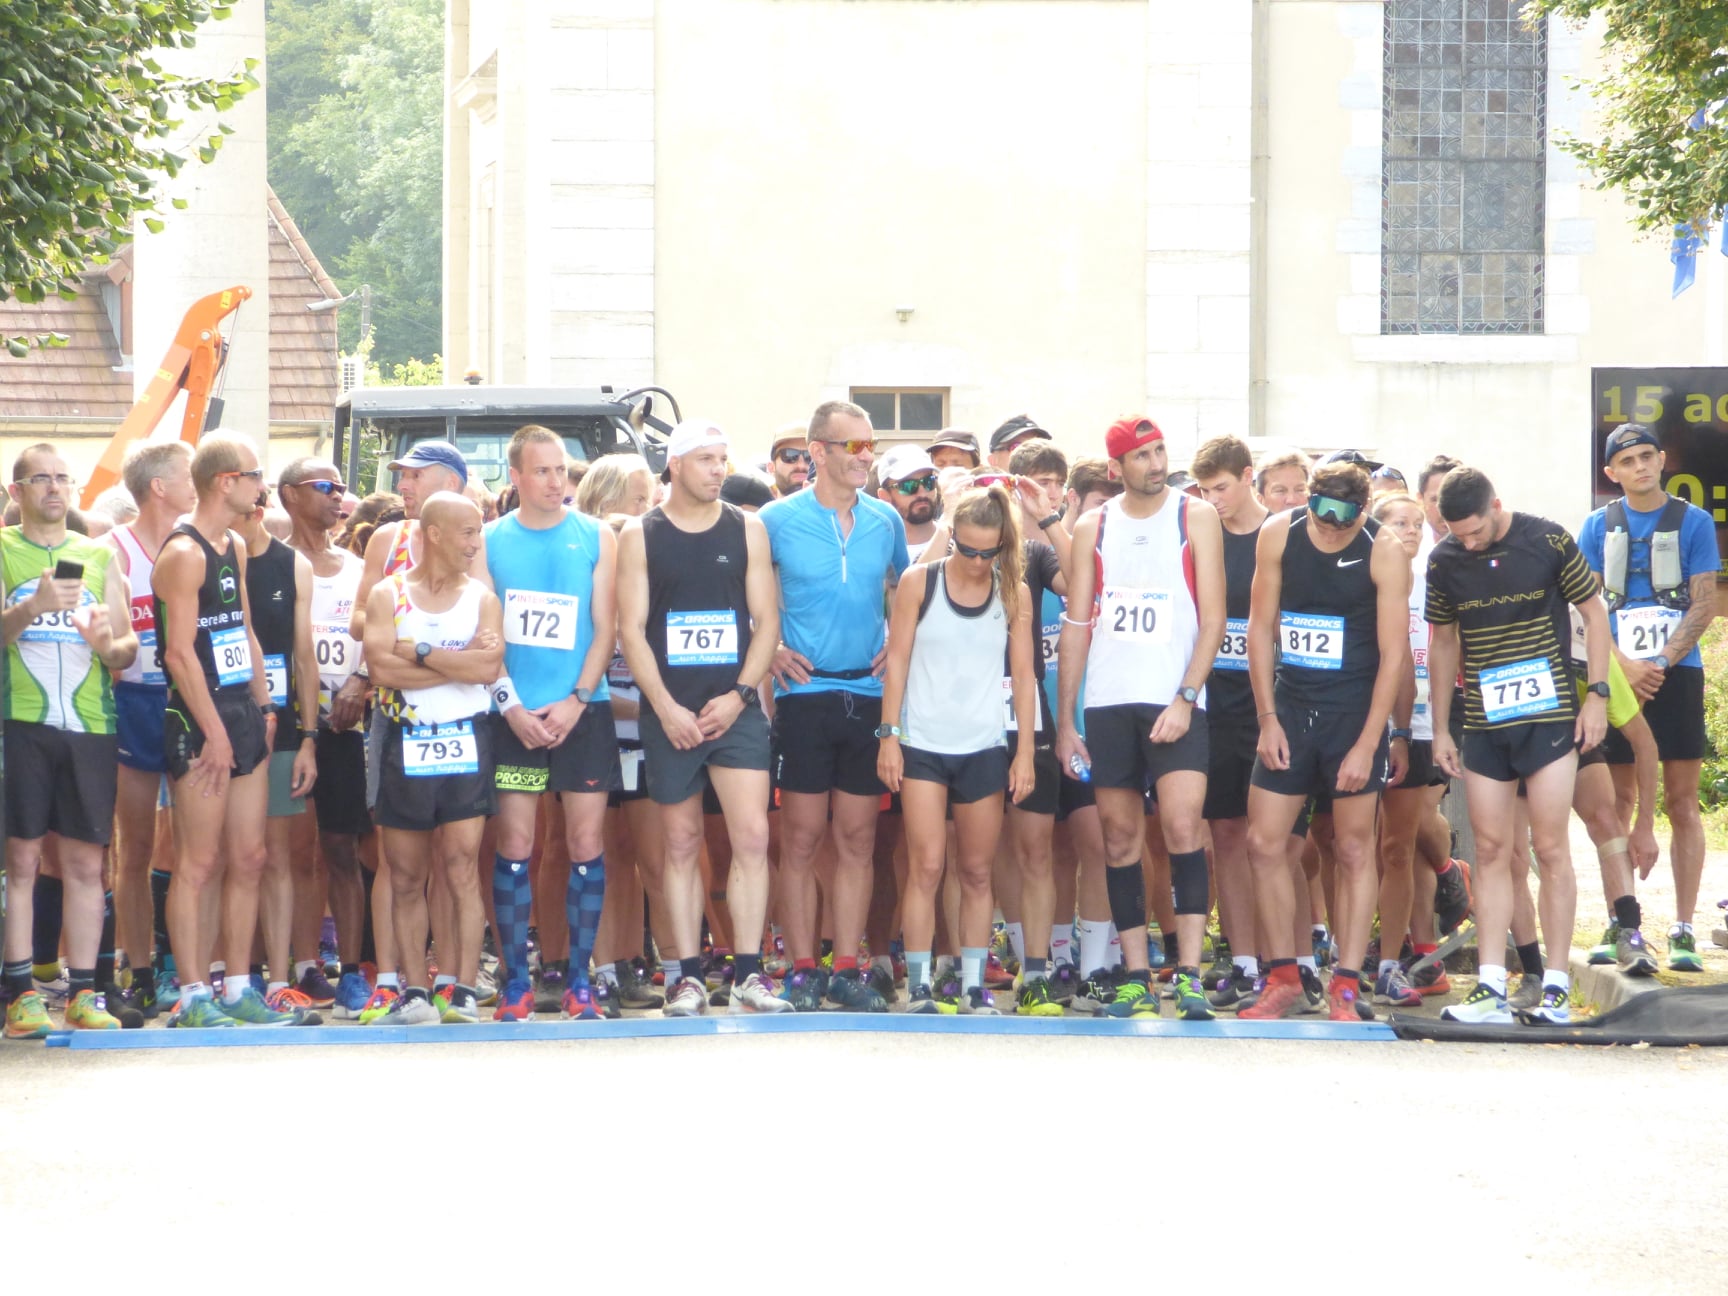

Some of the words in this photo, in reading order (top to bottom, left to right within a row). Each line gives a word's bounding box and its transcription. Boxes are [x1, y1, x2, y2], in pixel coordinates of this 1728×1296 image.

[1603, 386, 1664, 423] 15
[520, 609, 561, 639] 172
[684, 614, 734, 625] BROOKS
[1113, 605, 1156, 633] 210
[1292, 616, 1341, 629] BROOKS
[680, 628, 725, 650] 767
[1220, 635, 1248, 656] 83
[1289, 630, 1330, 654] 812
[1632, 623, 1669, 651] 211
[316, 639, 346, 666] 03
[699, 653, 728, 665] happy
[1303, 657, 1331, 669] happy
[1495, 661, 1548, 679] BROOKS
[1493, 678, 1542, 705] 773
[1515, 702, 1548, 715] happy
[416, 740, 464, 762] 793
